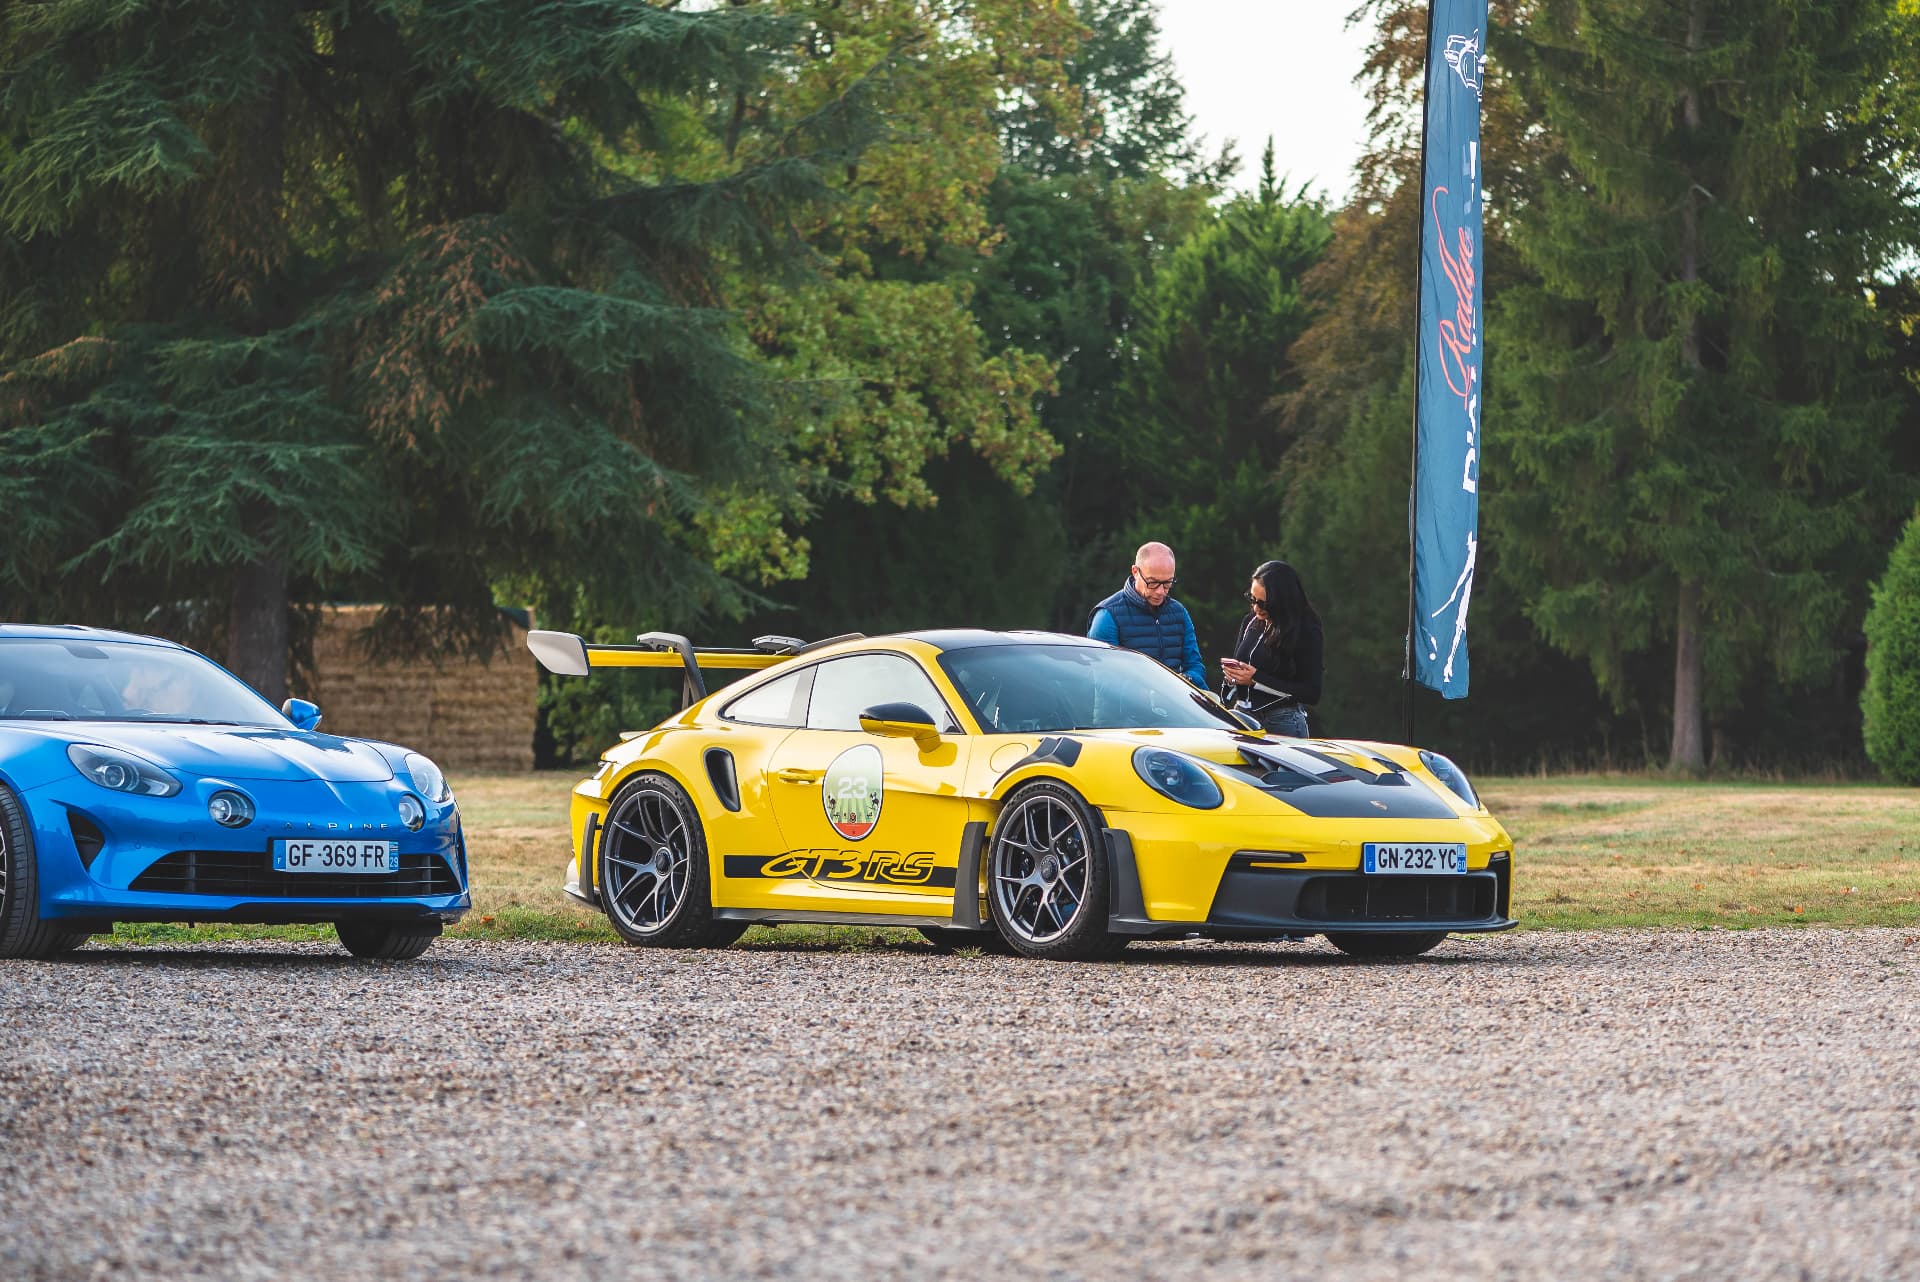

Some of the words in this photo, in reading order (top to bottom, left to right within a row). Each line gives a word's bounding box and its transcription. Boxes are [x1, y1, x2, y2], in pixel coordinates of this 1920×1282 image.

[1432, 186, 1475, 412] Rallye
[837, 776, 868, 799] 23
[284, 822, 389, 830] ALPINE
[389, 856, 398, 868] 29
[1457, 861, 1466, 871] 60
